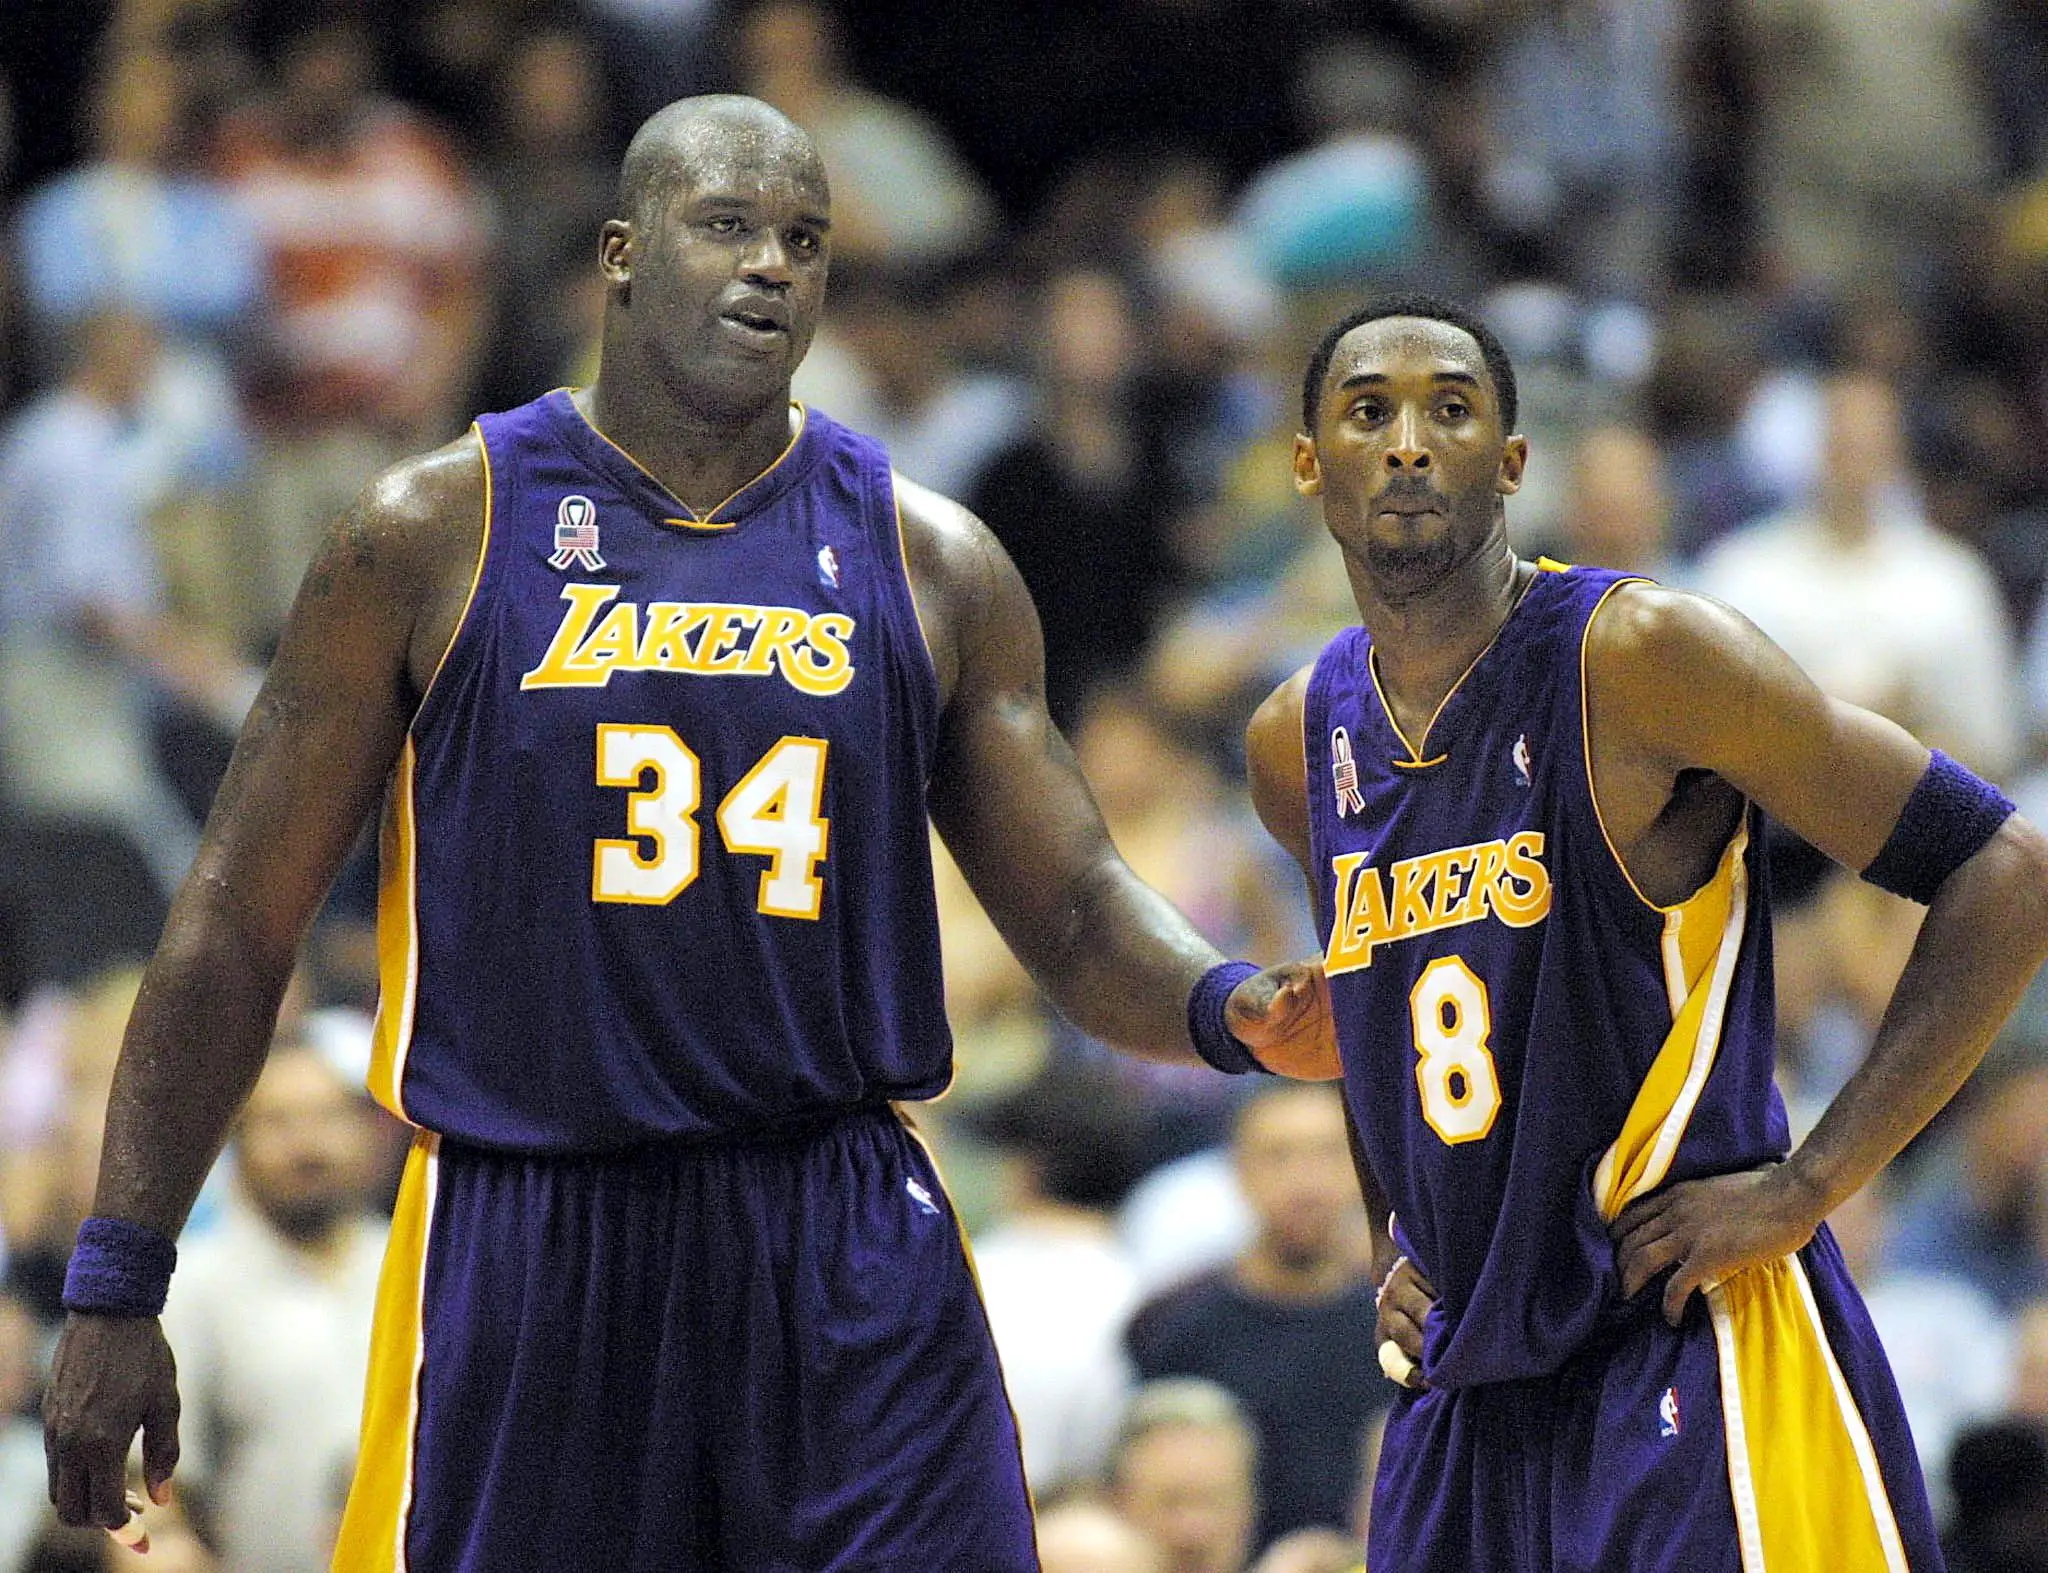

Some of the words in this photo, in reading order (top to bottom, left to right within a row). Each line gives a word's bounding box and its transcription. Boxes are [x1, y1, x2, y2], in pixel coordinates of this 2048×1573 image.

[520, 583, 855, 696] LAKERS
[592, 723, 829, 920] 34
[1324, 831, 1552, 978] LAKERS
[1409, 955, 1502, 1146] 8
